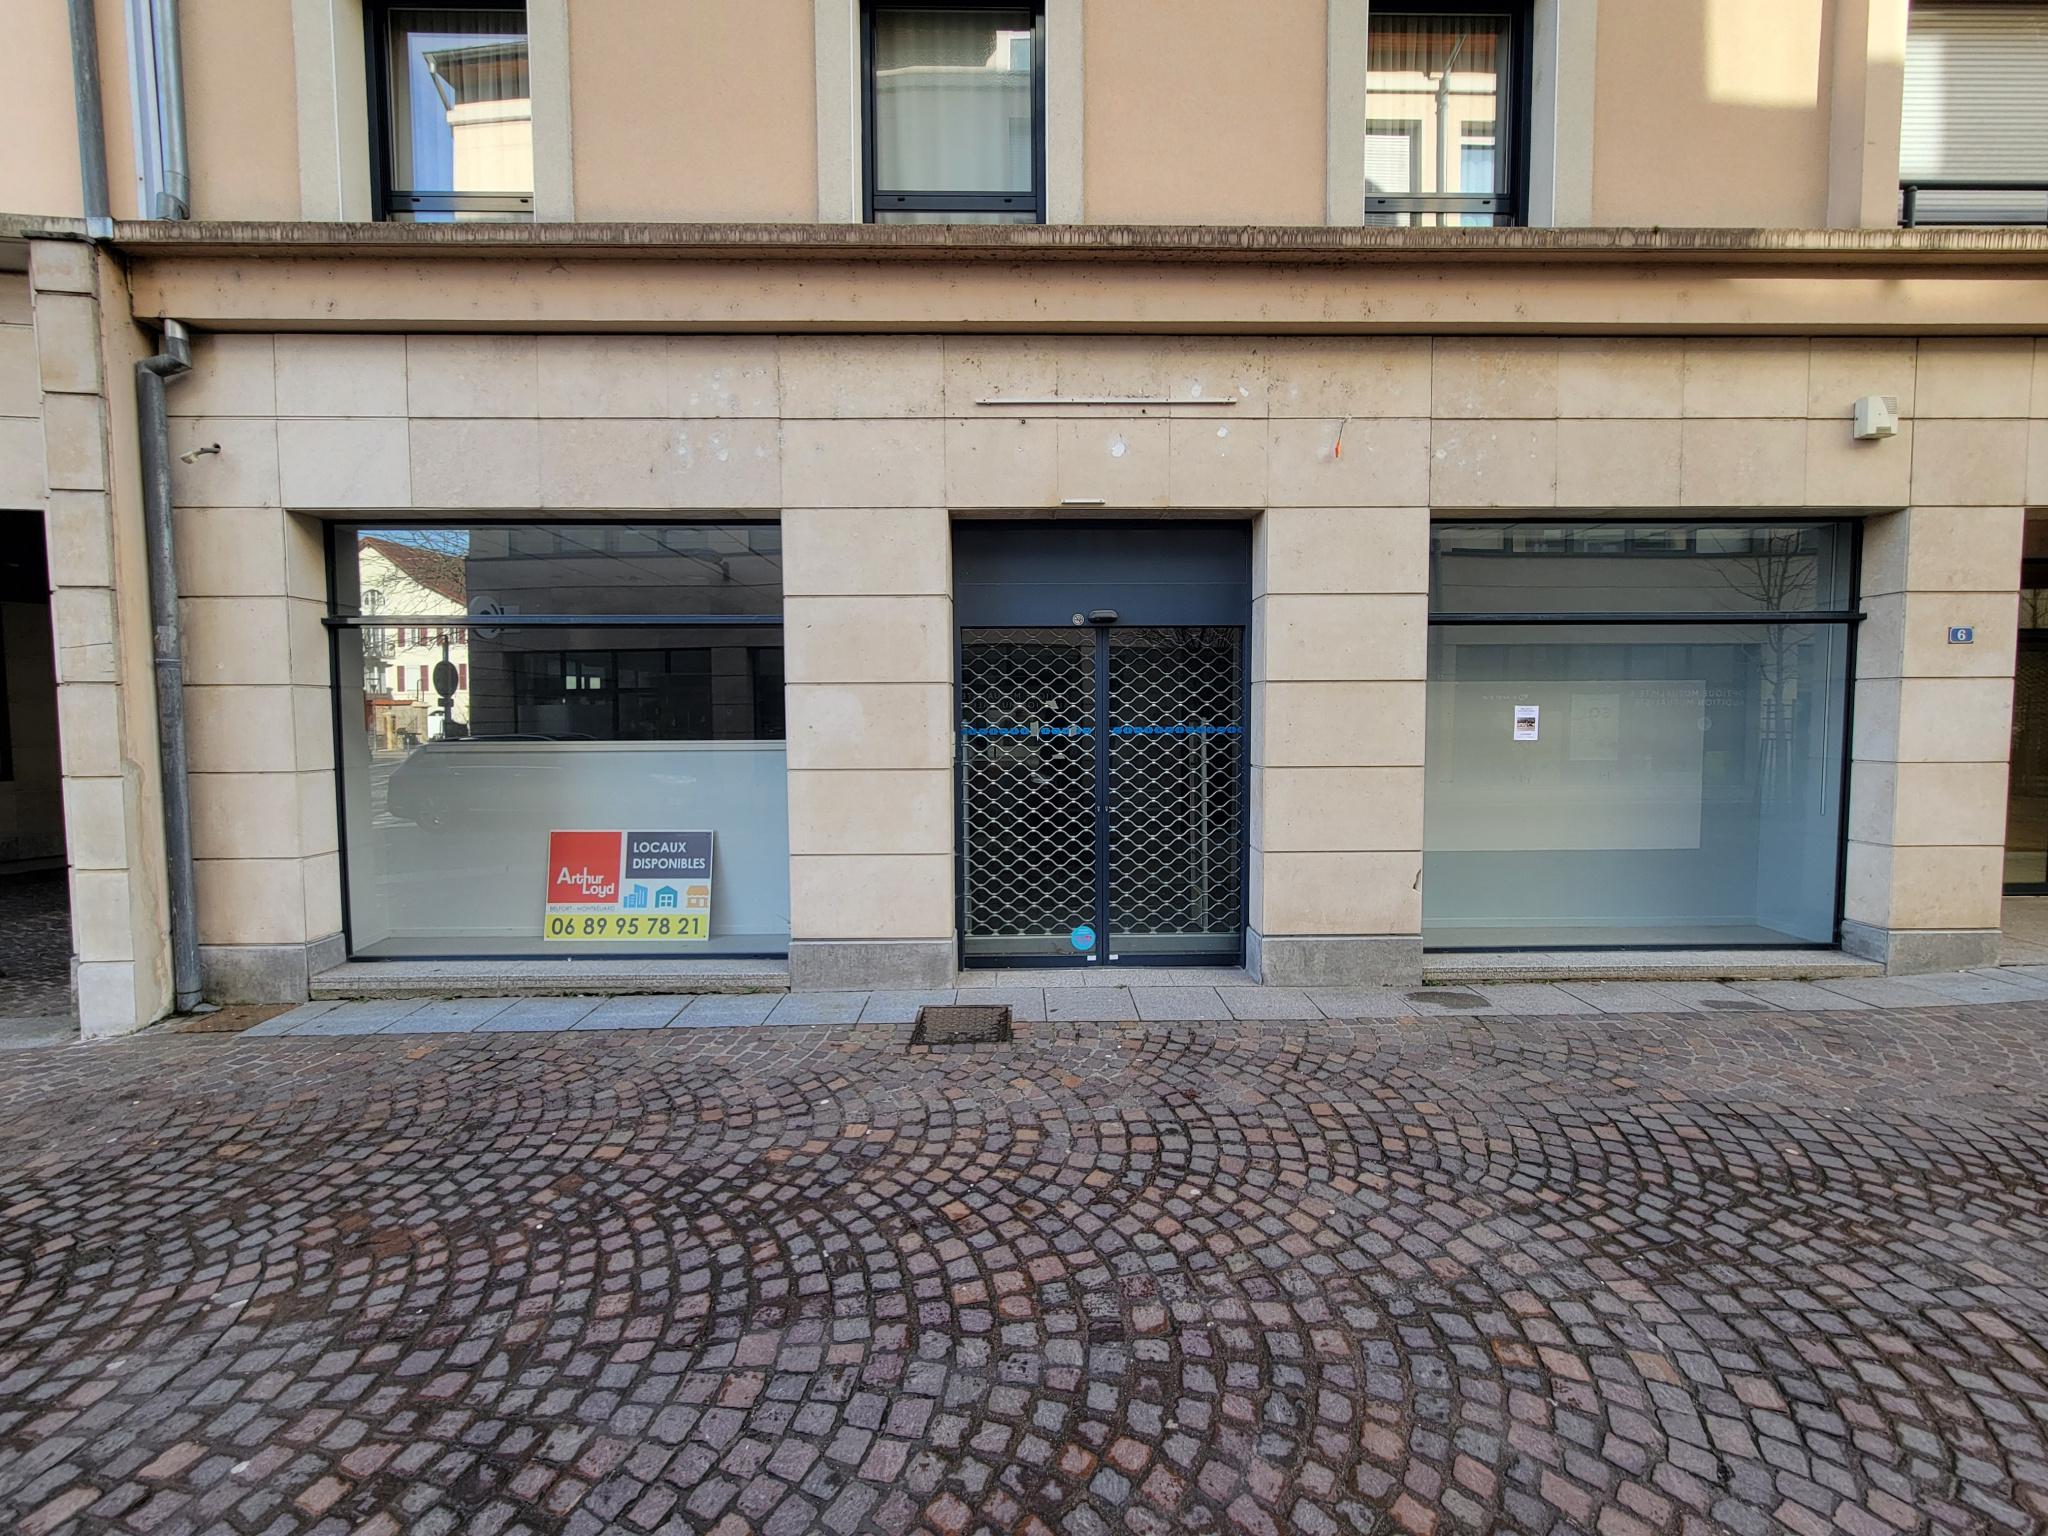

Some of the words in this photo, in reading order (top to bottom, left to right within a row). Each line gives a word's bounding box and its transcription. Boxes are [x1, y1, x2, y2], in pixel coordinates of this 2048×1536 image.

[1957, 629, 1966, 640] 6
[633, 842, 687, 853] LOCAUX
[632, 858, 706, 870] DISPONIBLES
[557, 867, 604, 885] Arthur
[582, 883, 614, 898] Loyd
[551, 918, 576, 935] 06
[583, 918, 608, 935] 89
[615, 918, 639, 935] 95
[647, 918, 670, 935] 78
[677, 918, 699, 935] 21
